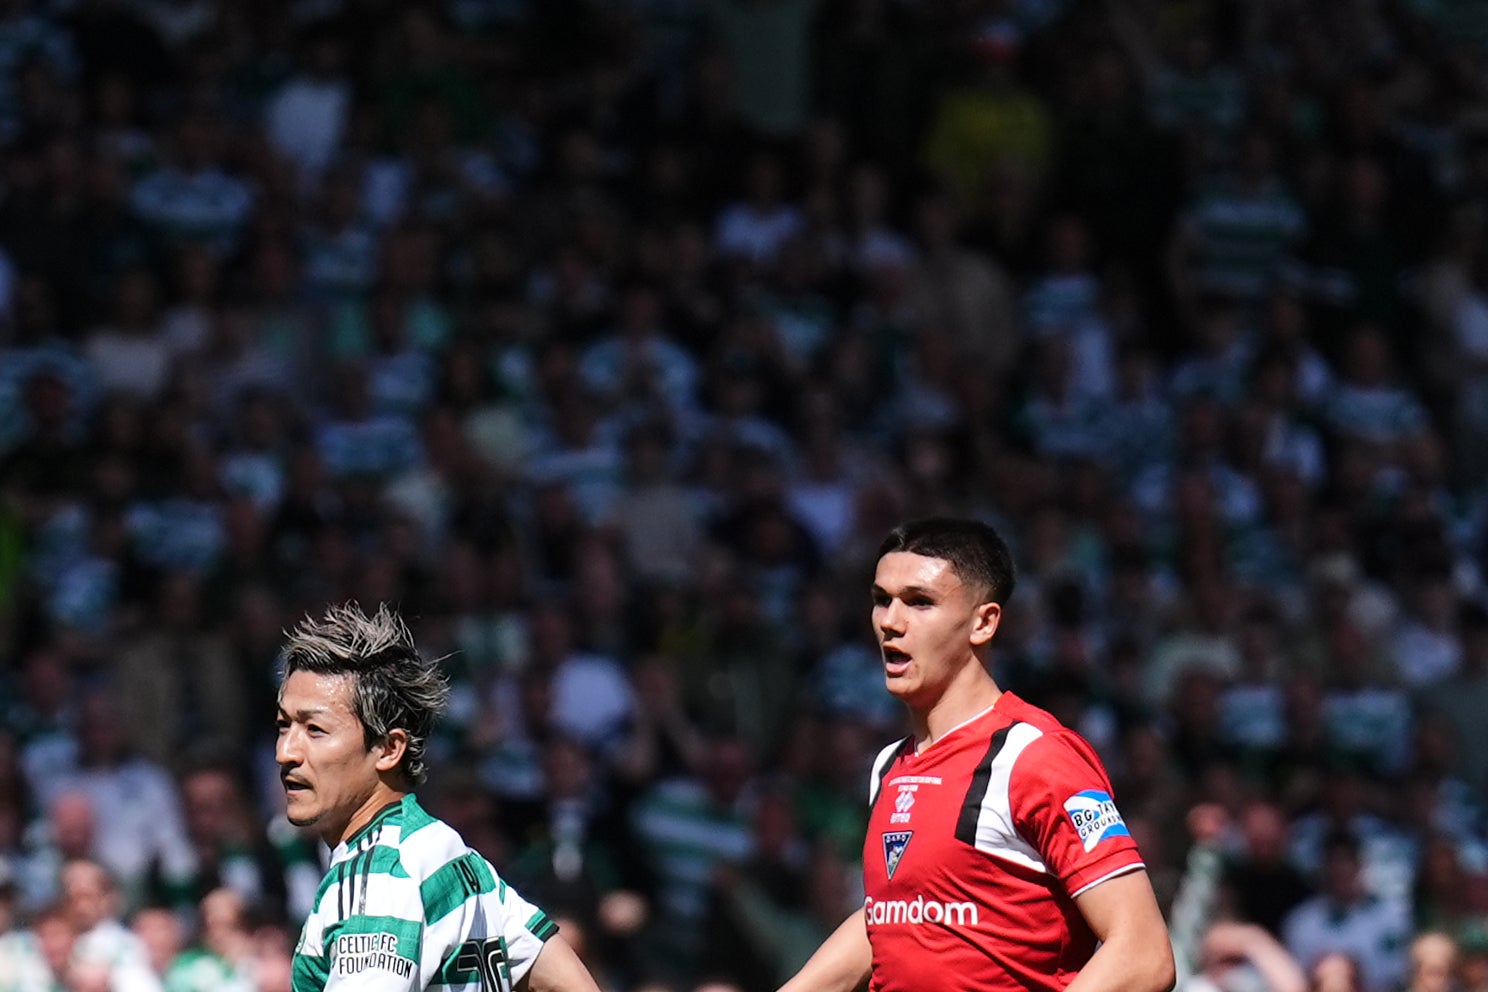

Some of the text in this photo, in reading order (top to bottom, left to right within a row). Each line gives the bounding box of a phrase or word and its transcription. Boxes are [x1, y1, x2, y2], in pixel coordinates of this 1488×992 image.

[1073, 809, 1093, 827] BG
[864, 894, 979, 926] Gamdom
[339, 934, 396, 954] CELTIC FC
[339, 952, 413, 980] FOUNDATION
